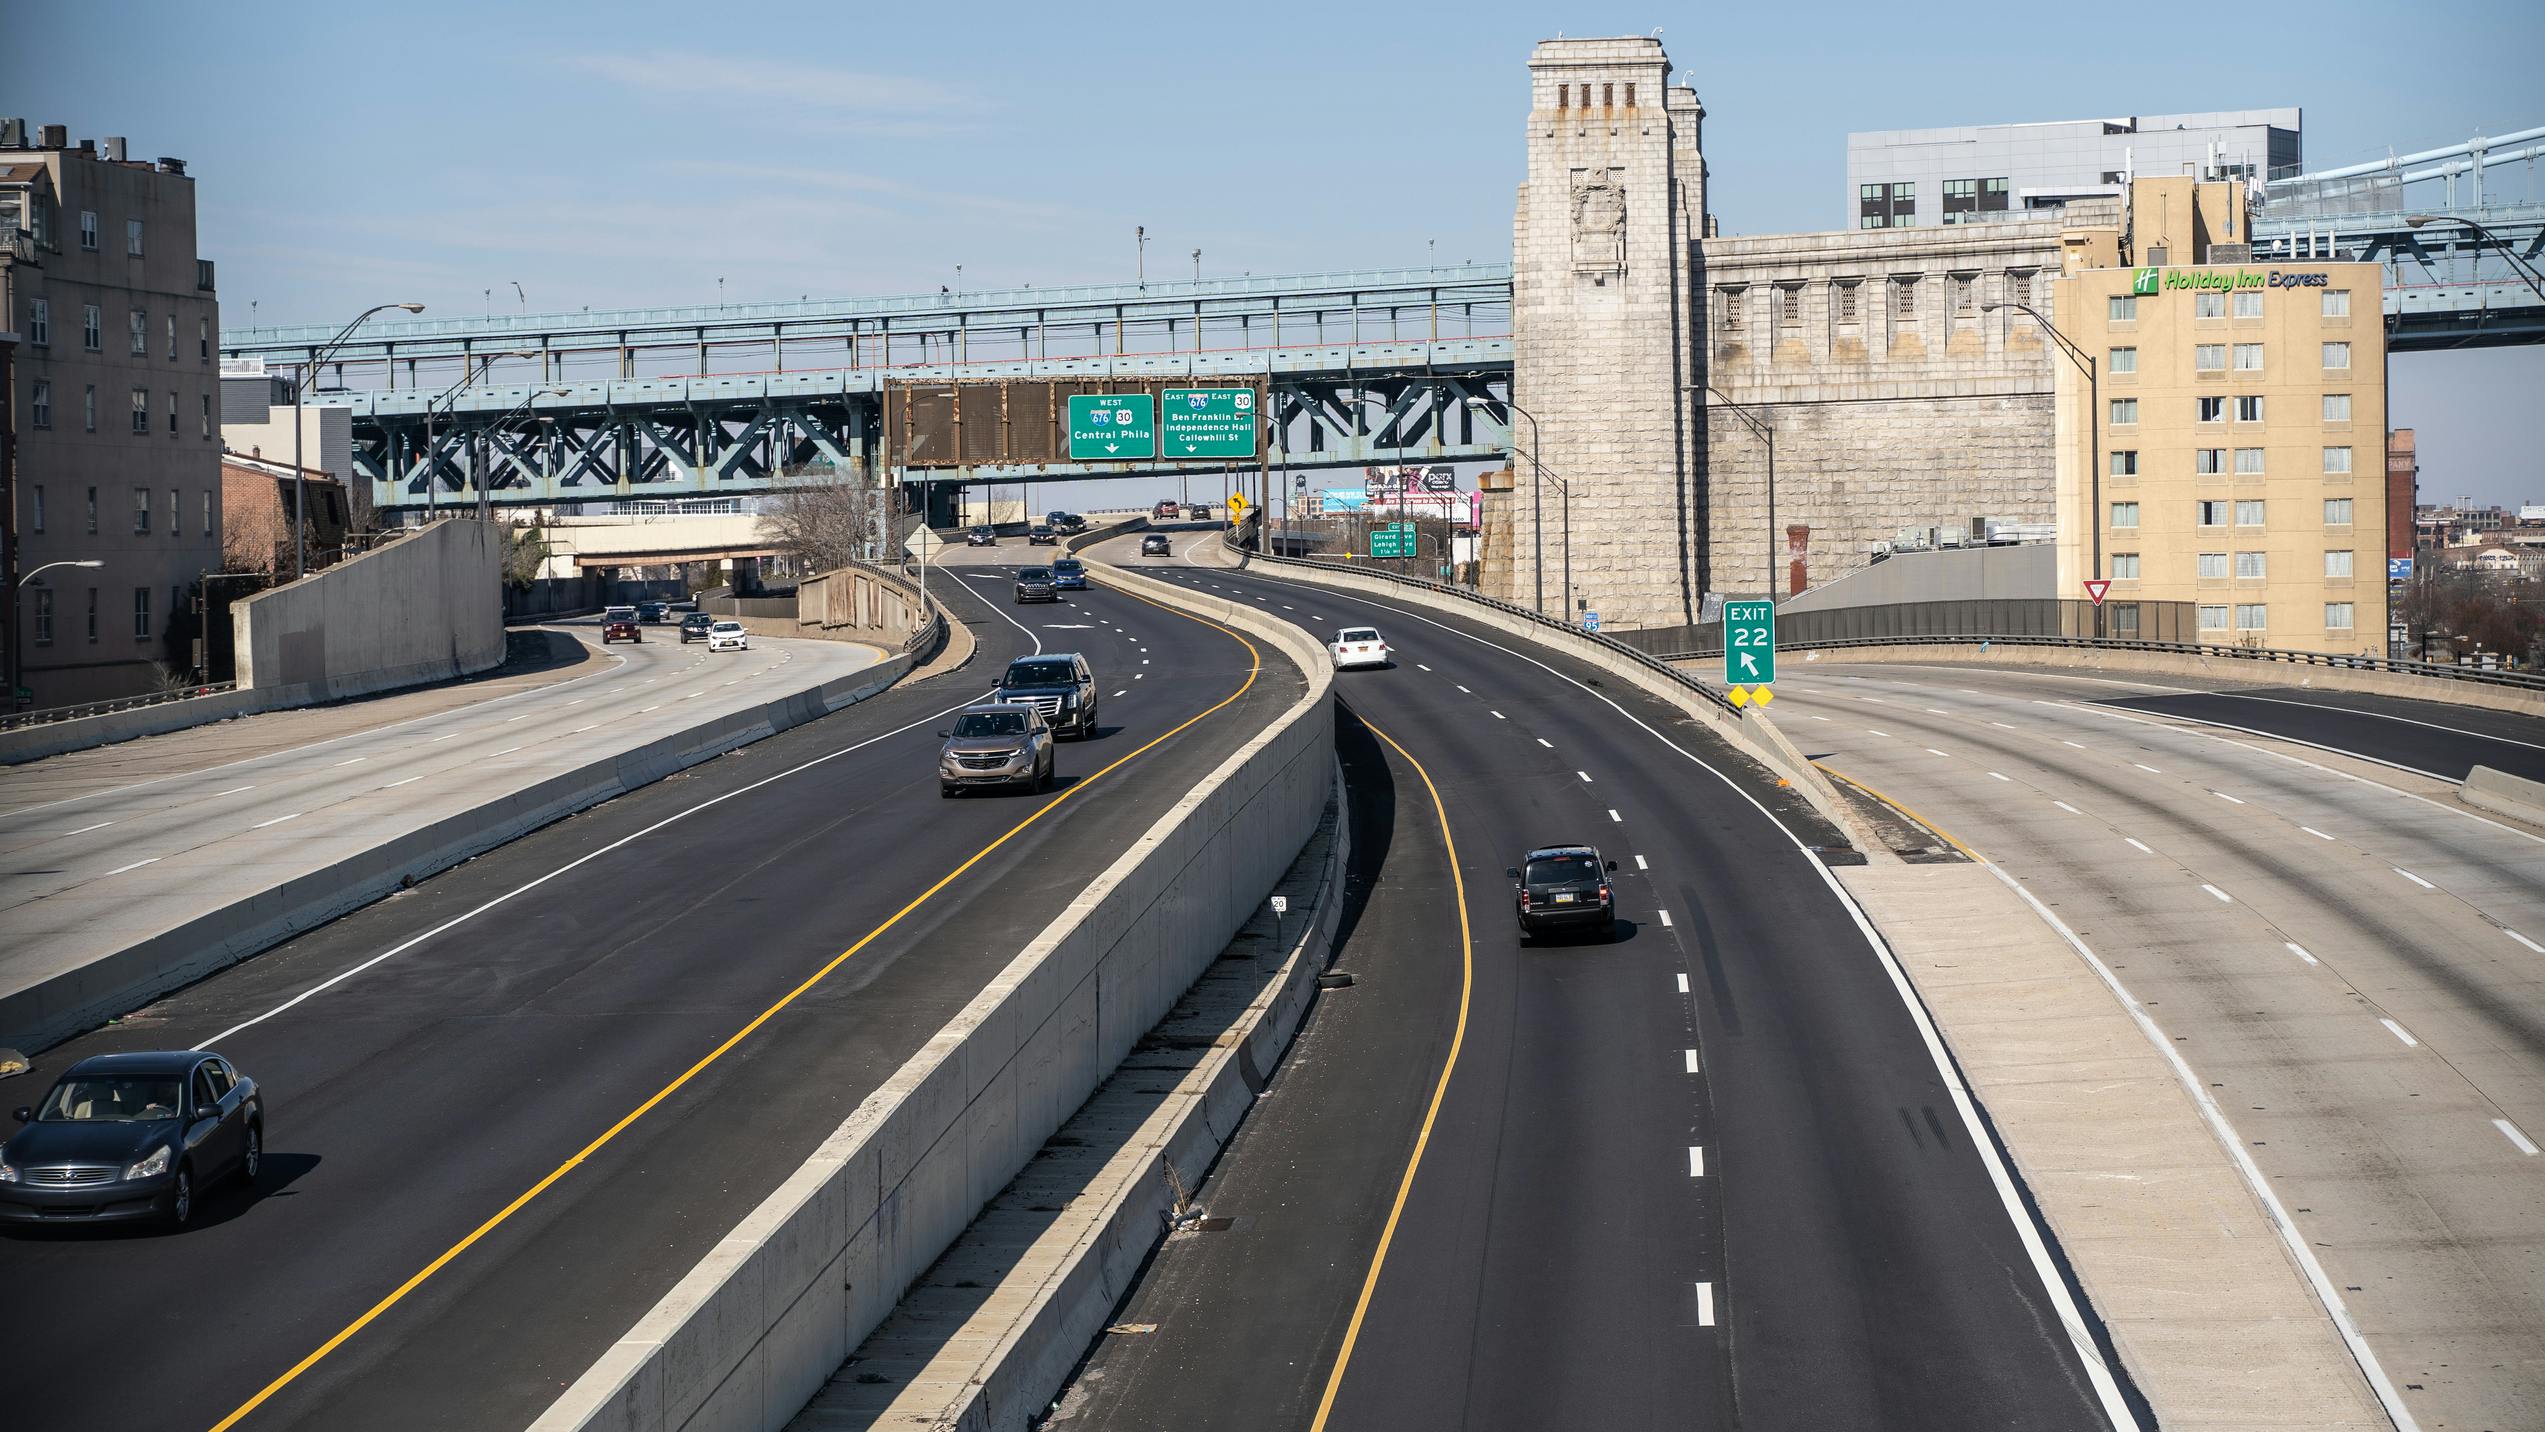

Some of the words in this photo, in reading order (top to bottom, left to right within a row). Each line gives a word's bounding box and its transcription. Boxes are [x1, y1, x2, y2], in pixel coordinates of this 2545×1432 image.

[2165, 269, 2235, 292] Holiday
[2236, 268, 2265, 288] Inn
[2268, 270, 2328, 291] Express
[1190, 398, 1206, 407] 676
[1236, 397, 1250, 406] 30
[1093, 413, 1109, 422] 676
[1118, 412, 1131, 421] 30
[1172, 413, 1189, 421] Ben
[1192, 413, 1231, 421] Franklin
[1166, 424, 1229, 432] Independence
[1232, 423, 1251, 431] Hall
[1074, 430, 1116, 439] Central
[1121, 430, 1150, 439] Phila
[1228, 433, 1239, 441] St
[1731, 608, 1767, 620] EXIT
[1585, 621, 1598, 631] 95
[1734, 627, 1768, 647] 22
[1273, 900, 1284, 908] 20
